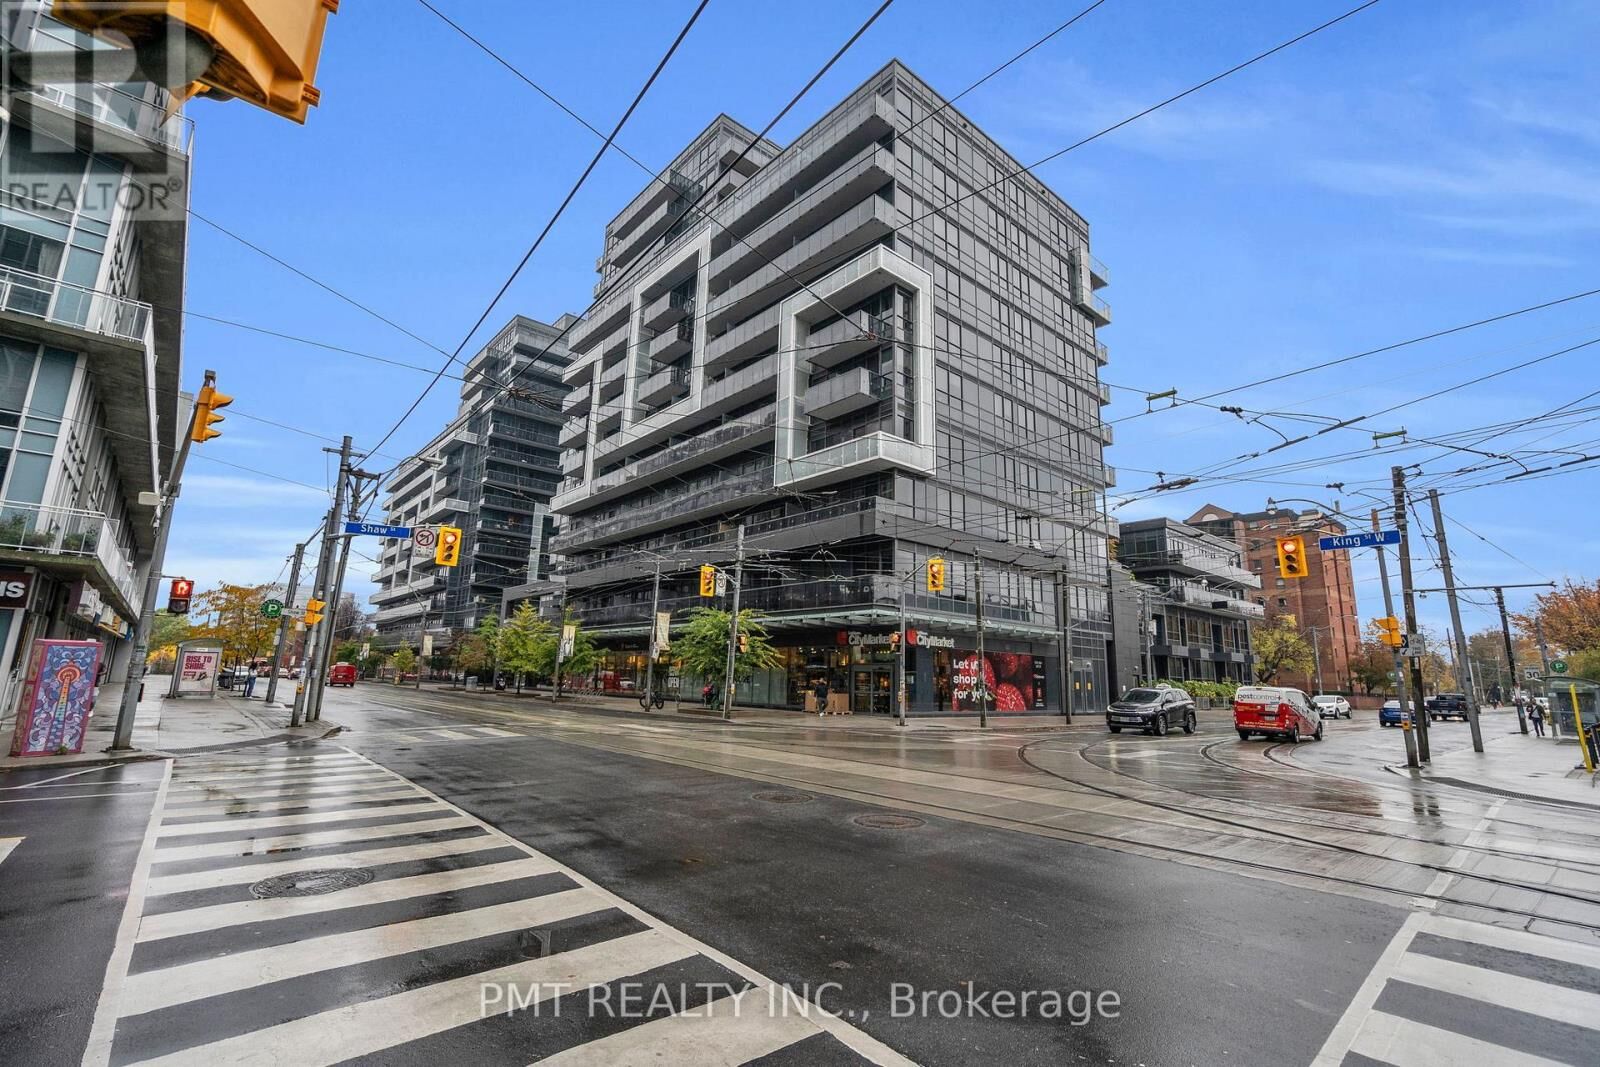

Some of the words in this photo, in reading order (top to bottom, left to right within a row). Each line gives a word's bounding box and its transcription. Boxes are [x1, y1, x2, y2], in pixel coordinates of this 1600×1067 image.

[360, 524, 387, 534] Shaw
[1333, 536, 1360, 546] King
[1375, 532, 1385, 542] W
[848, 634, 891, 647] CityMarke
[916, 635, 955, 648] CityMarket
[185, 655, 202, 663] RISE
[953, 659, 969, 669] Let
[953, 673, 977, 686] shop
[1526, 671, 1539, 679] 30
[953, 688, 968, 699] for
